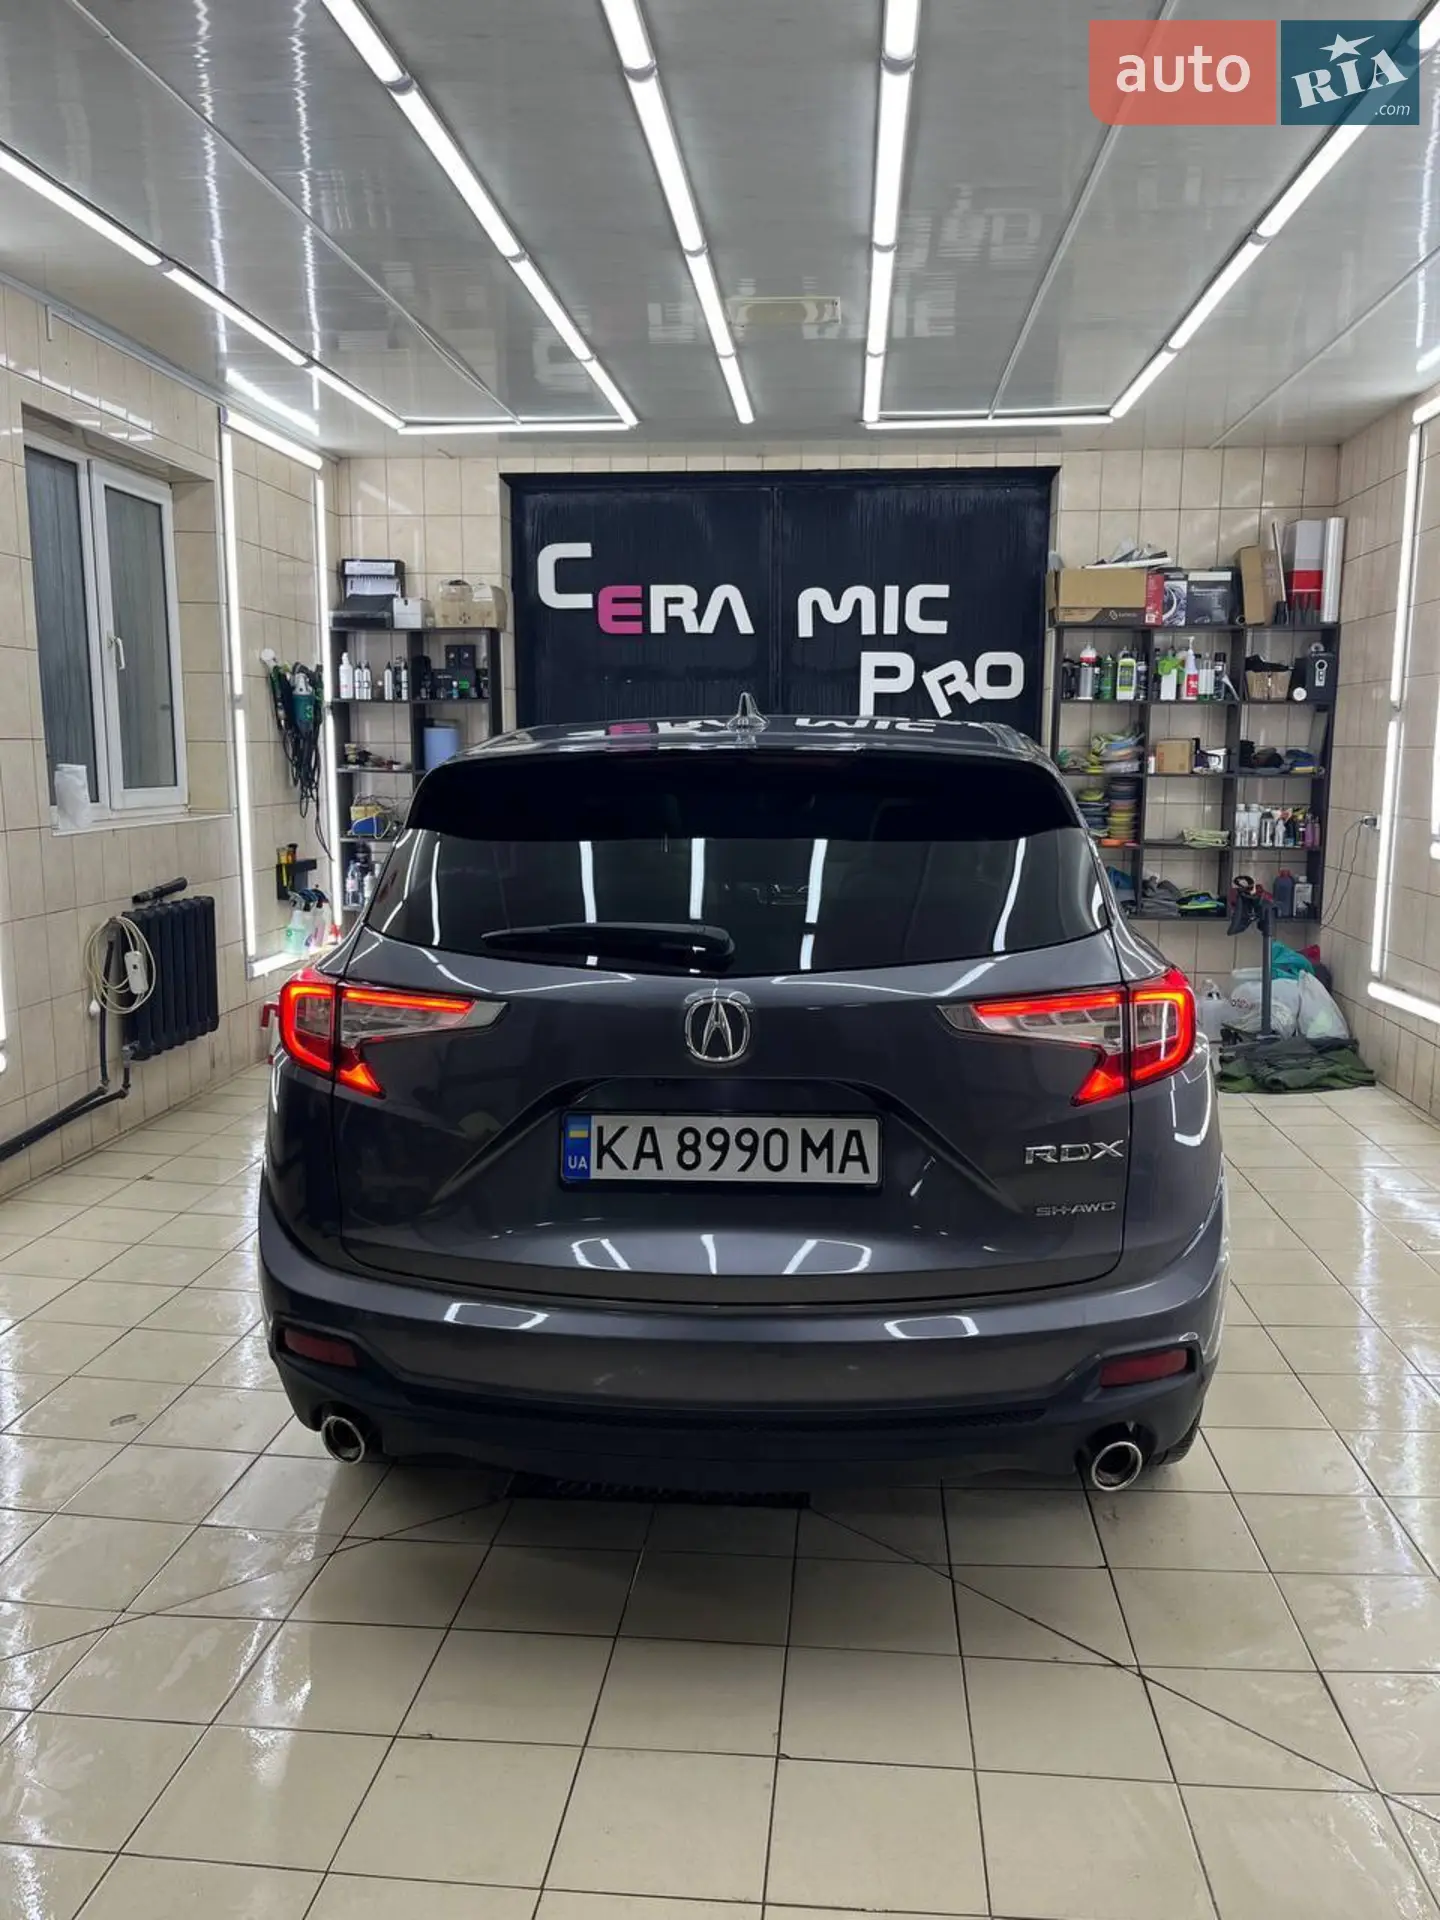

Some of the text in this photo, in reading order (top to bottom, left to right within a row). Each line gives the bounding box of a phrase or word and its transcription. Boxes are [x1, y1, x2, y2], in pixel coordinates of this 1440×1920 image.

[859, 651, 1024, 718] PRO
[568, 1155, 588, 1170] UA
[596, 1125, 870, 1174] KA 8990 MA
[1025, 1139, 1124, 1164] RDX
